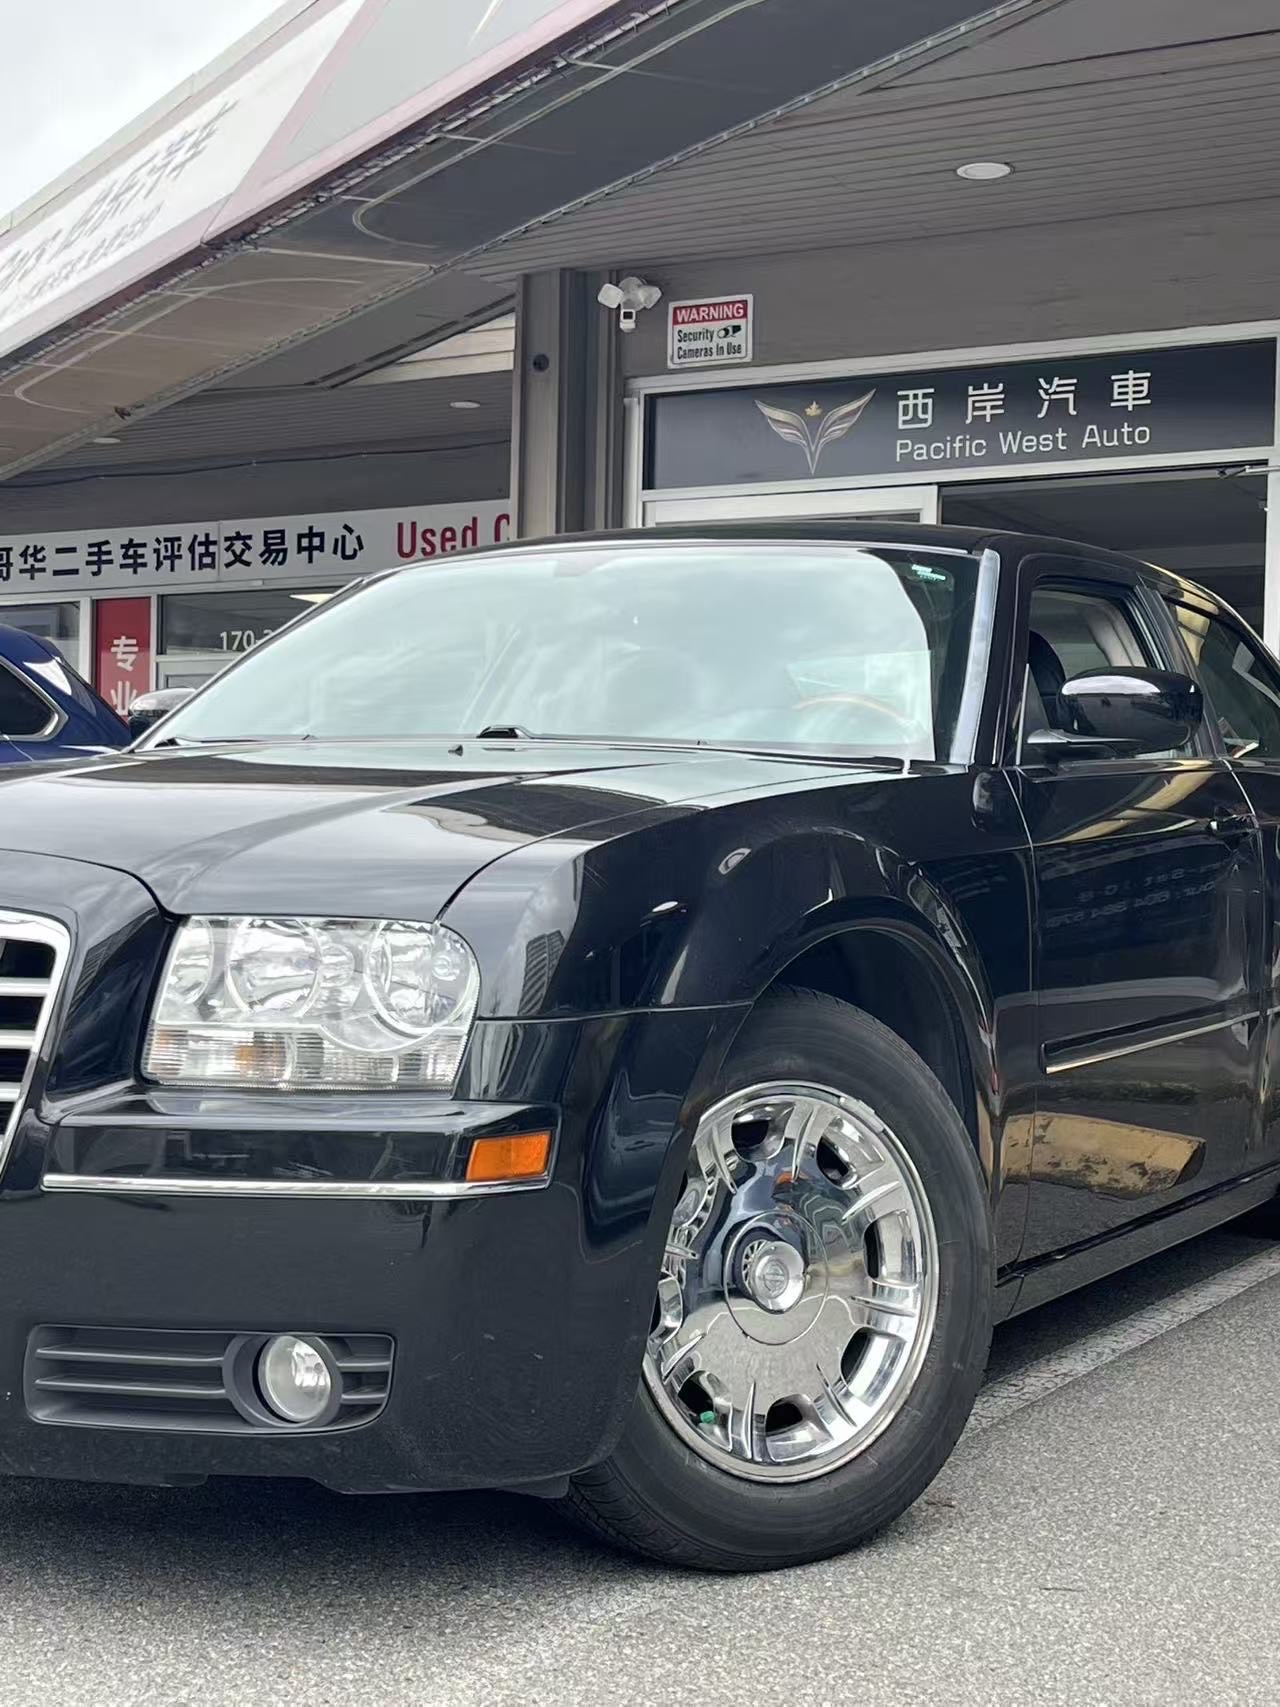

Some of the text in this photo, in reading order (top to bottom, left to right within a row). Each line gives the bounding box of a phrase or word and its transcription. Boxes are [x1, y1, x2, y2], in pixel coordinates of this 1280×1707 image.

[677, 303, 744, 322] WARNING
[677, 328, 714, 343] Security
[677, 342, 742, 360] Cameras In Use
[897, 370, 1151, 430] 西岸汽車
[896, 422, 1150, 462] Pacific West Auto
[397, 516, 478, 558] Used
